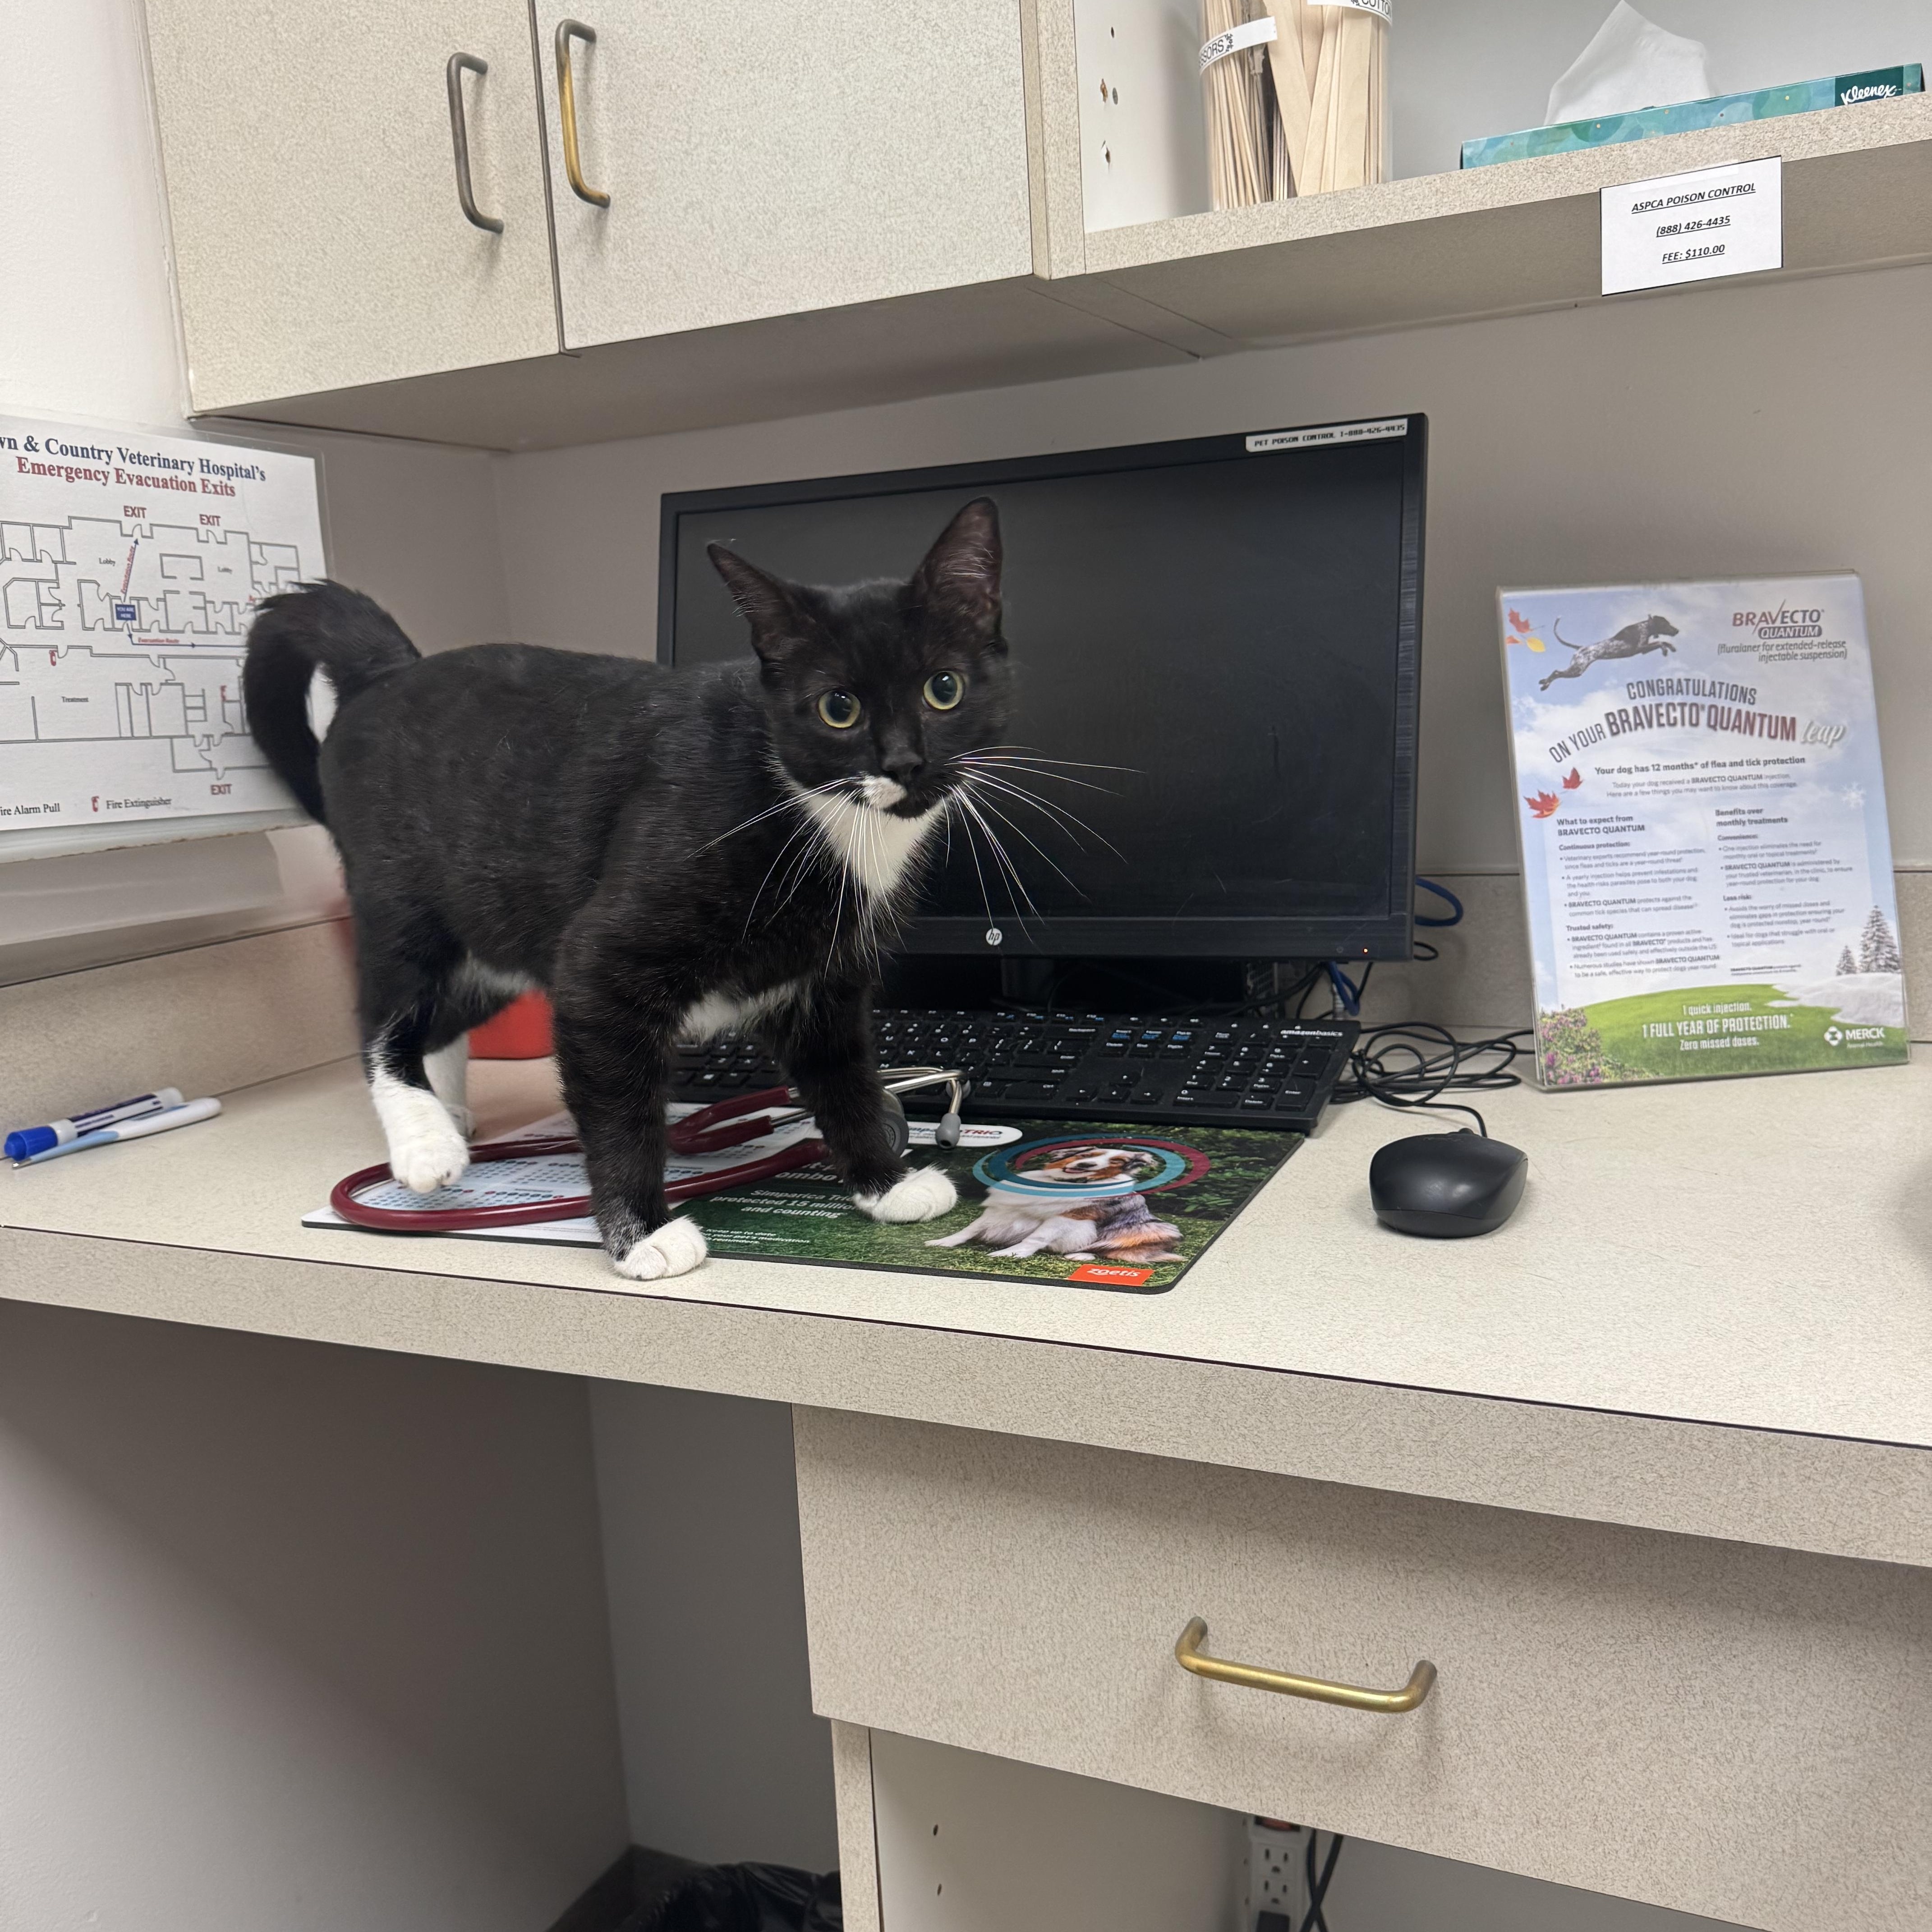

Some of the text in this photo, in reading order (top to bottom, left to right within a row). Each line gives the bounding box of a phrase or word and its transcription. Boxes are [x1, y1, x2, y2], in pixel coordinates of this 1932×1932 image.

[1840, 85, 1896, 105] Kleenex
[1632, 183, 1756, 213] ASPCA POISON CONTROL
[1656, 215, 1731, 237] (888) 426-4435
[1662, 244, 1725, 262] FEE: $110.00
[1272, 436, 1299, 445] POISON
[1302, 432, 1336, 442] CONTROL
[23, 435, 40, 452] &
[45, 437, 113, 465] Country
[117, 446, 194, 476] Veterinary
[198, 458, 267, 481] Hospital's
[15, 455, 235, 497] Emergency Evacuation Exits
[123, 505, 147, 519] EXIT
[199, 514, 221, 526] EXIT
[99, 557, 115, 566] Lobby
[1760, 625, 1818, 638] QUANTUM
[1762, 641, 1773, 652] for
[1775, 639, 1846, 651] extended-release
[1758, 648, 1848, 664] injectable suspension)
[1626, 678, 1757, 706] CONGRATULATIONS
[1549, 740, 1571, 764] ON
[1569, 723, 1607, 751] YOUR
[1707, 704, 1797, 742] QUANTUM
[1800, 720, 1846, 748] leap
[1595, 767, 1615, 775] Your
[1616, 765, 1633, 775] dog
[1651, 764, 1661, 772] 12
[1711, 760, 1726, 768] flea
[1729, 759, 1744, 767] and
[1745, 758, 1761, 766] tick
[1763, 756, 1806, 767] protection
[1691, 775, 1726, 784] BRAVECTO
[1727, 773, 1763, 782] QUANTUM
[210, 784, 232, 796] EXIT
[14, 805, 41, 815] Alarm
[43, 803, 60, 813] Pull
[106, 797, 172, 810] Fire Extinguisher
[1588, 816, 1614, 825] expect
[1716, 816, 1789, 827] monthly treatments
[1558, 824, 1645, 836] BRAVECTO QUANTUM
[1602, 897, 1636, 907] QUANTUM
[988, 928, 1001, 946] hp
[1604, 932, 1637, 941] QUANTUM
[1688, 1003, 1711, 1016] quick
[1713, 1001, 1752, 1015] injection.
[1280, 1029, 1344, 1037] amazonbasics
[1642, 1024, 1647, 1039] 1
[1649, 1022, 1674, 1038] FULL
[1676, 1020, 1703, 1036] YEAR
[1706, 1019, 1720, 1035] OF
[1845, 1027, 1886, 1040] MERCK
[1679, 1035, 1759, 1051] Zero missed doses.
[775, 1171, 837, 1181] ombo
[710, 1195, 789, 1206] protected
[751, 1190, 826, 1200] Simparica
[741, 1205, 842, 1219] and counting
[1087, 1268, 1141, 1277] zoetis
